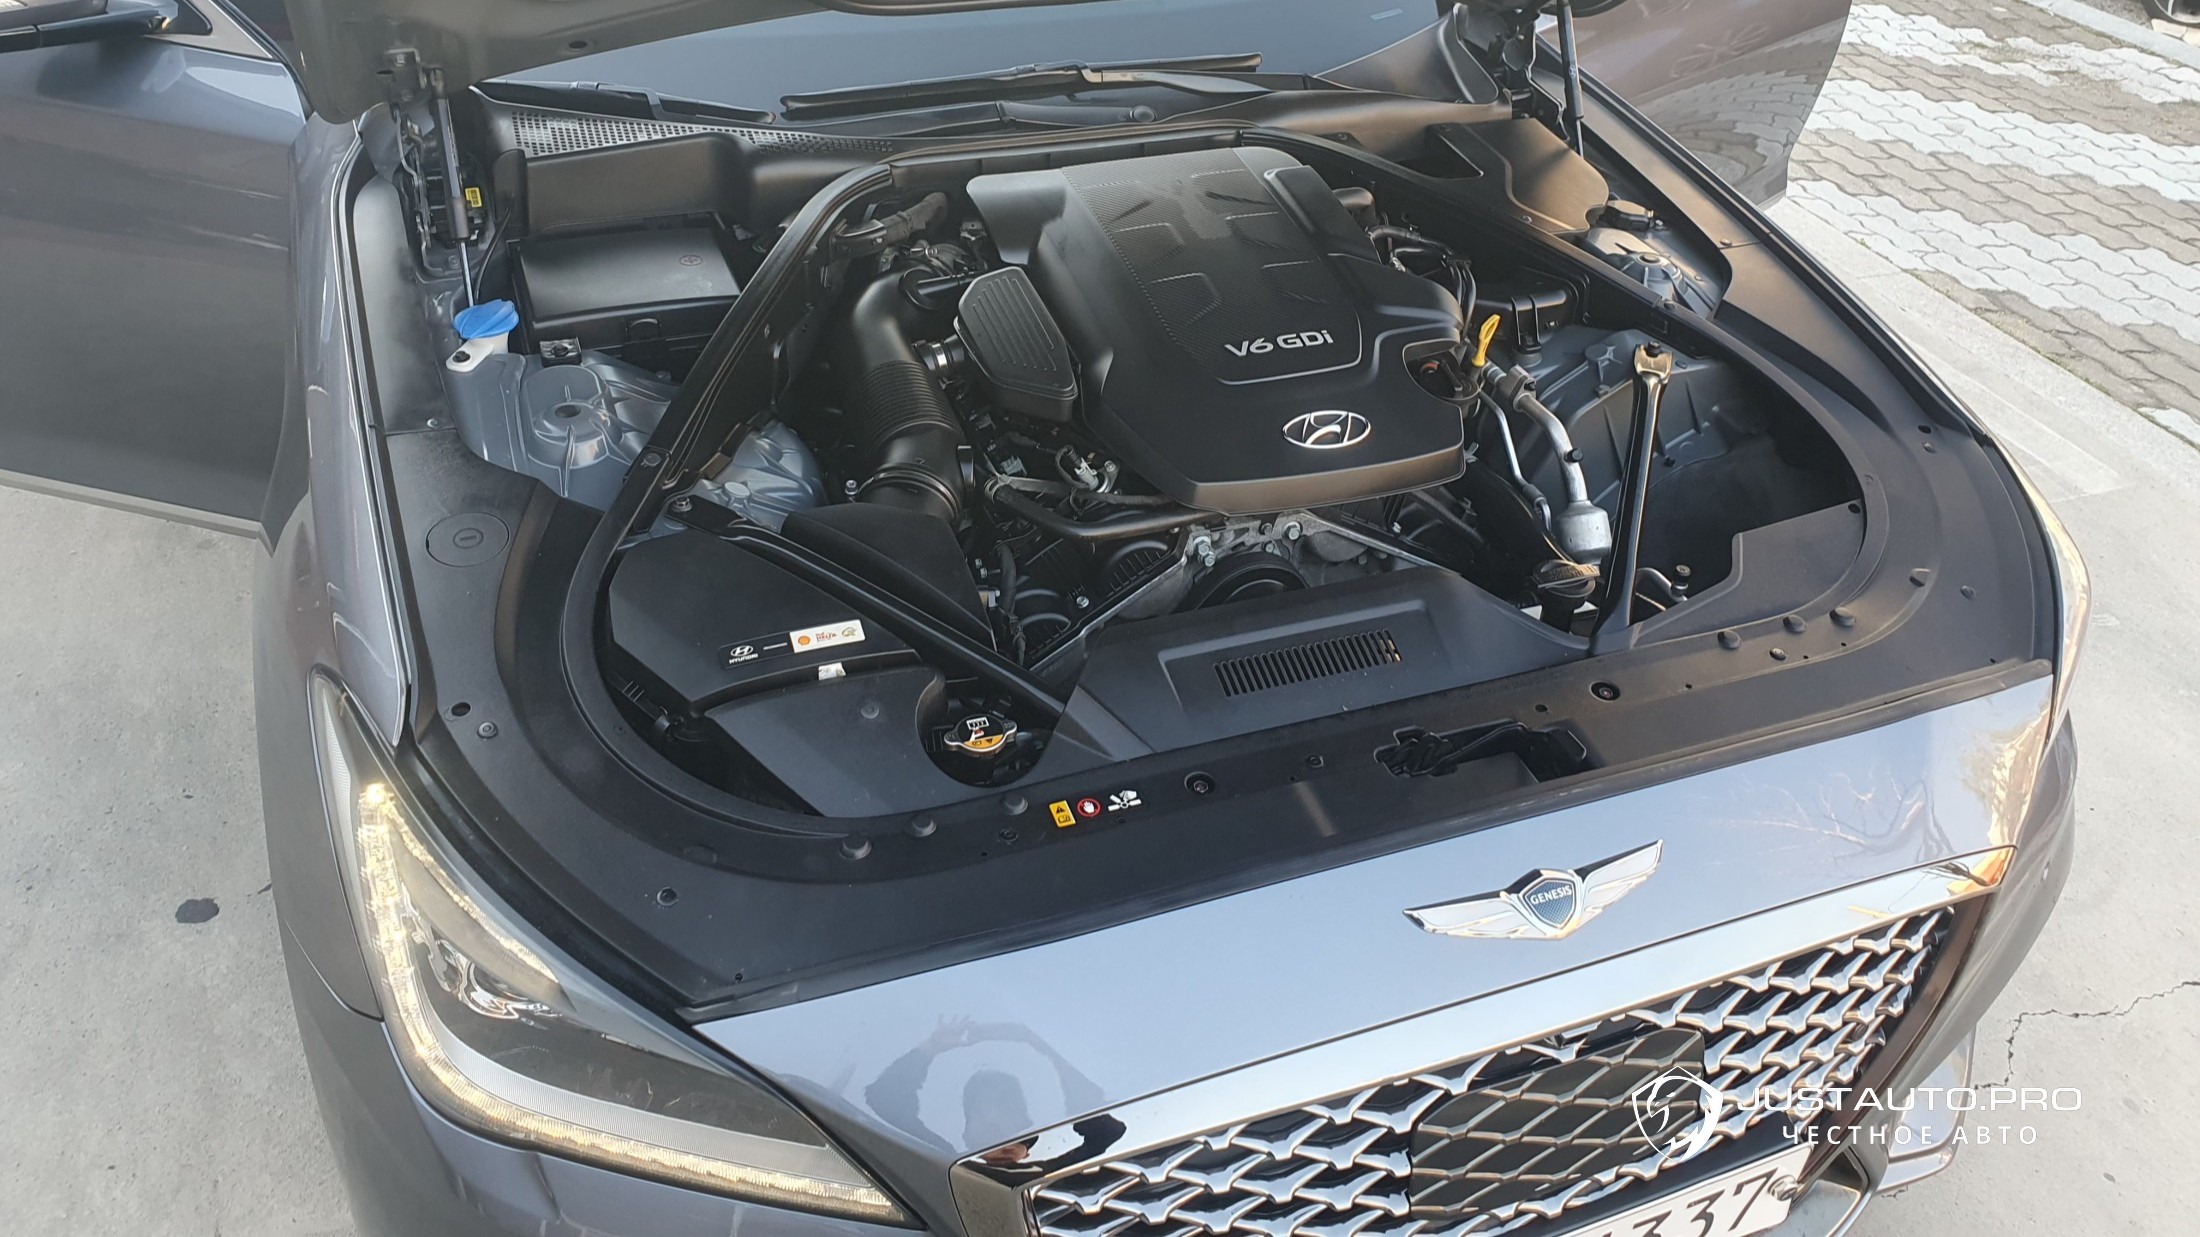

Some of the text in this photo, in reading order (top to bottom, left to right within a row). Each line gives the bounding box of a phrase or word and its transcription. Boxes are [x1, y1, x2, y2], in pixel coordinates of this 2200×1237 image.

[1224, 330, 1334, 358] V6 GDi
[729, 653, 759, 664] HYUNDAI
[1530, 885, 1573, 905] GENESIS
[1602, 1166, 1780, 1237] 337
